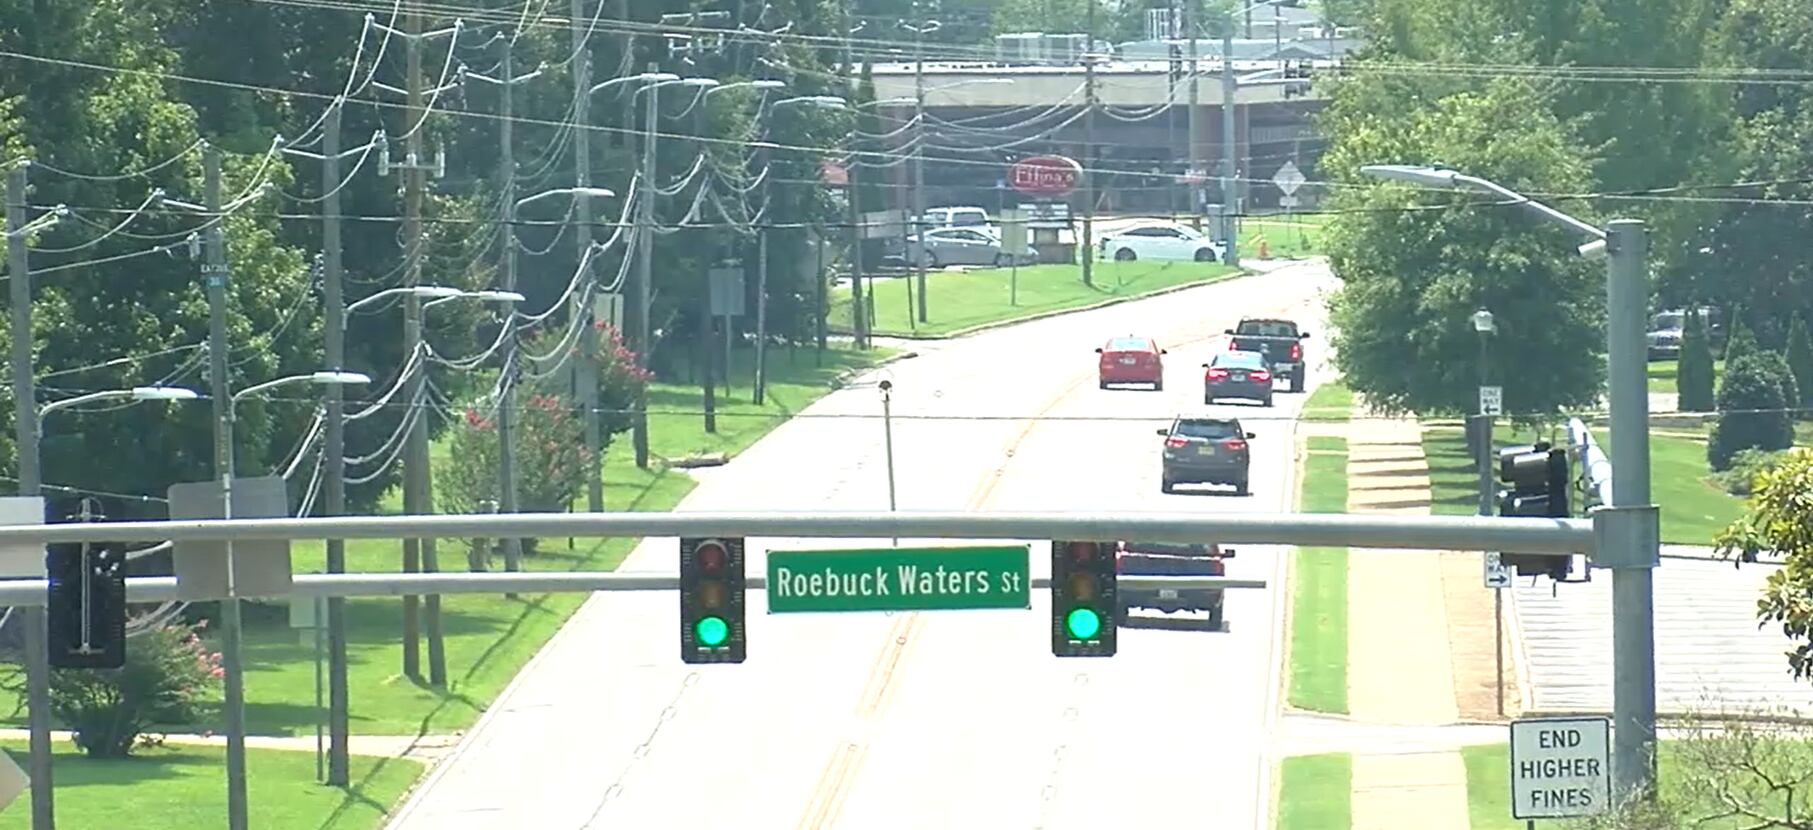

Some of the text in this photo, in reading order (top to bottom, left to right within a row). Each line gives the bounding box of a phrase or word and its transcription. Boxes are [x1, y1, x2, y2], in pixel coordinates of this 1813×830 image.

[777, 565, 1020, 597] Roebuck Waters St
[1540, 730, 1580, 748] END
[1521, 758, 1600, 779] HIGHER
[1531, 788, 1592, 808] FINES
